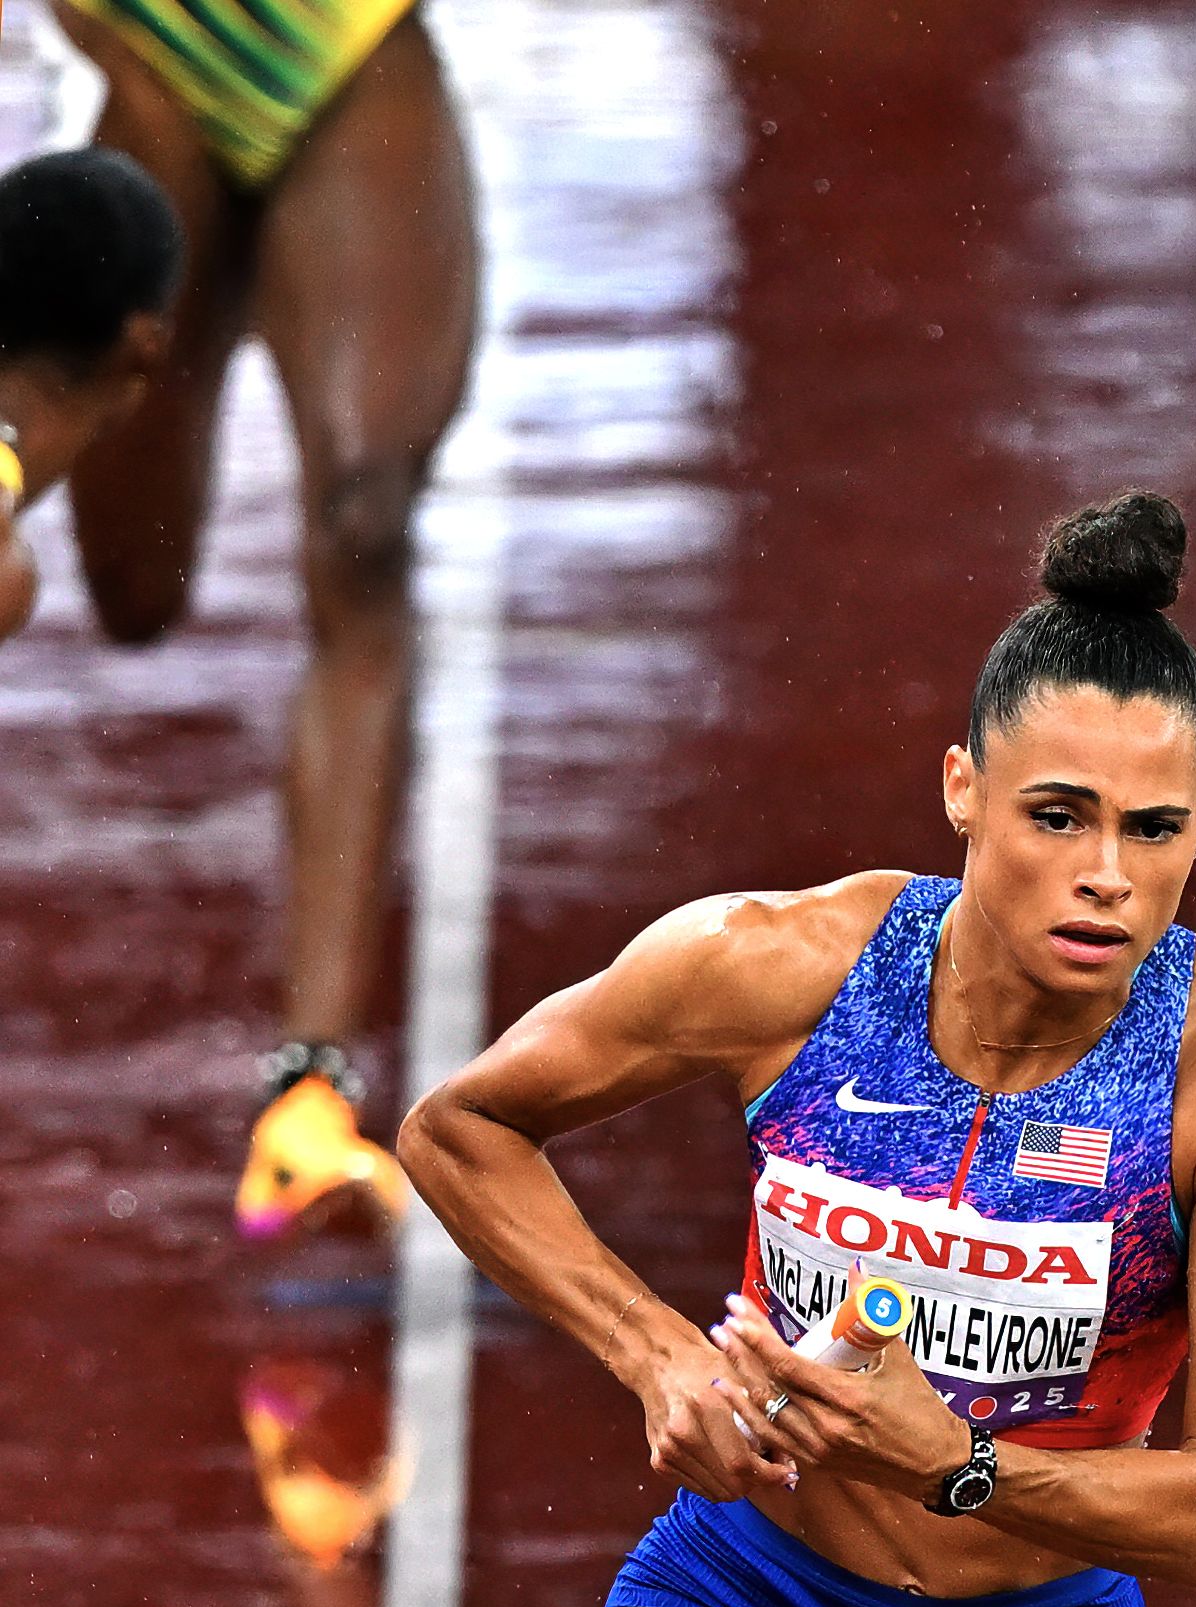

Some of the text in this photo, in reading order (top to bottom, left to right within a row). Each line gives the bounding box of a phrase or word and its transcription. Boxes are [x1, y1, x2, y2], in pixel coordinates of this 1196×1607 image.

[762, 1179, 1097, 1285] HONDA
[875, 1296, 893, 1319] 5
[1010, 1386, 1066, 1413] 25
